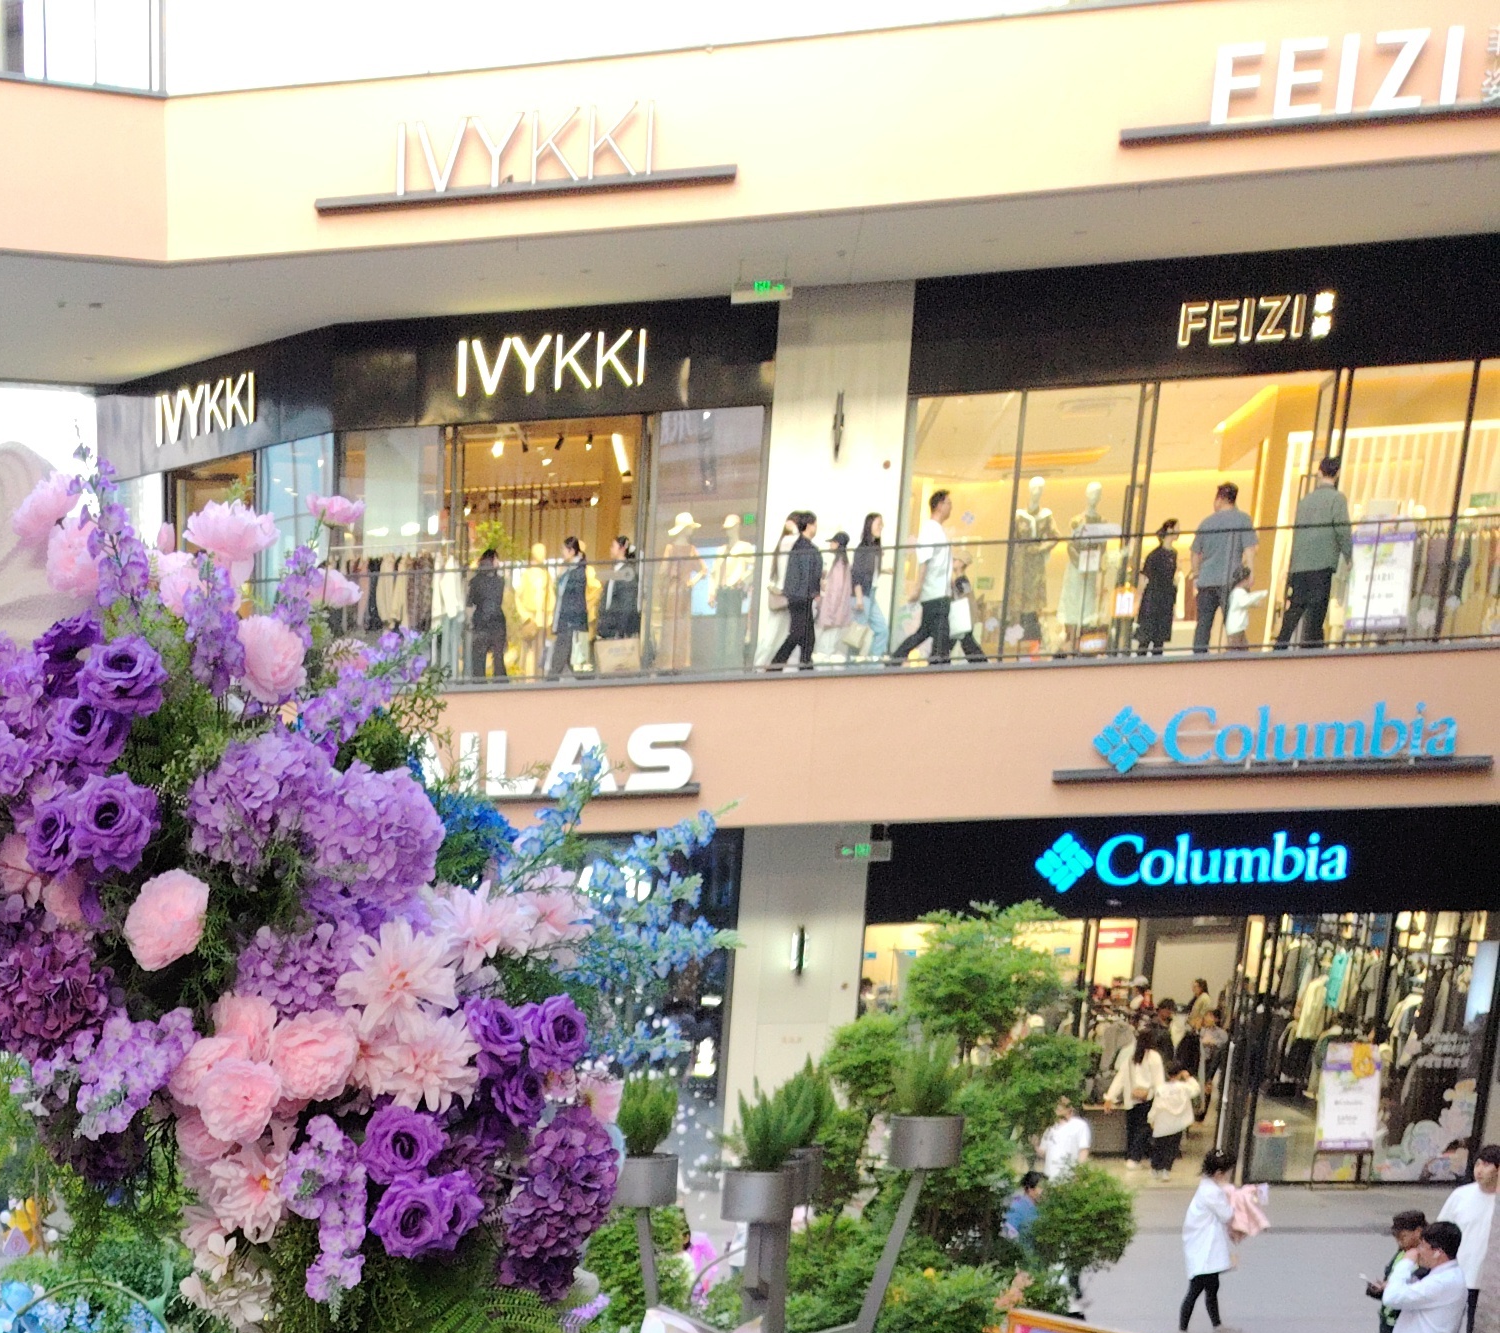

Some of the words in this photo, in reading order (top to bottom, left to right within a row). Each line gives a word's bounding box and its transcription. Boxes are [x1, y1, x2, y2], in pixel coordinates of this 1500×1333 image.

[1210, 25, 1465, 125] FEIZI
[396, 99, 655, 196] IVYKKI
[1177, 294, 1307, 348] FEIZI
[457, 328, 647, 397] IVYKKI
[154, 371, 257, 447] IVYKKI
[1162, 701, 1457, 765] Columbia
[1096, 831, 1347, 887] Columbia
